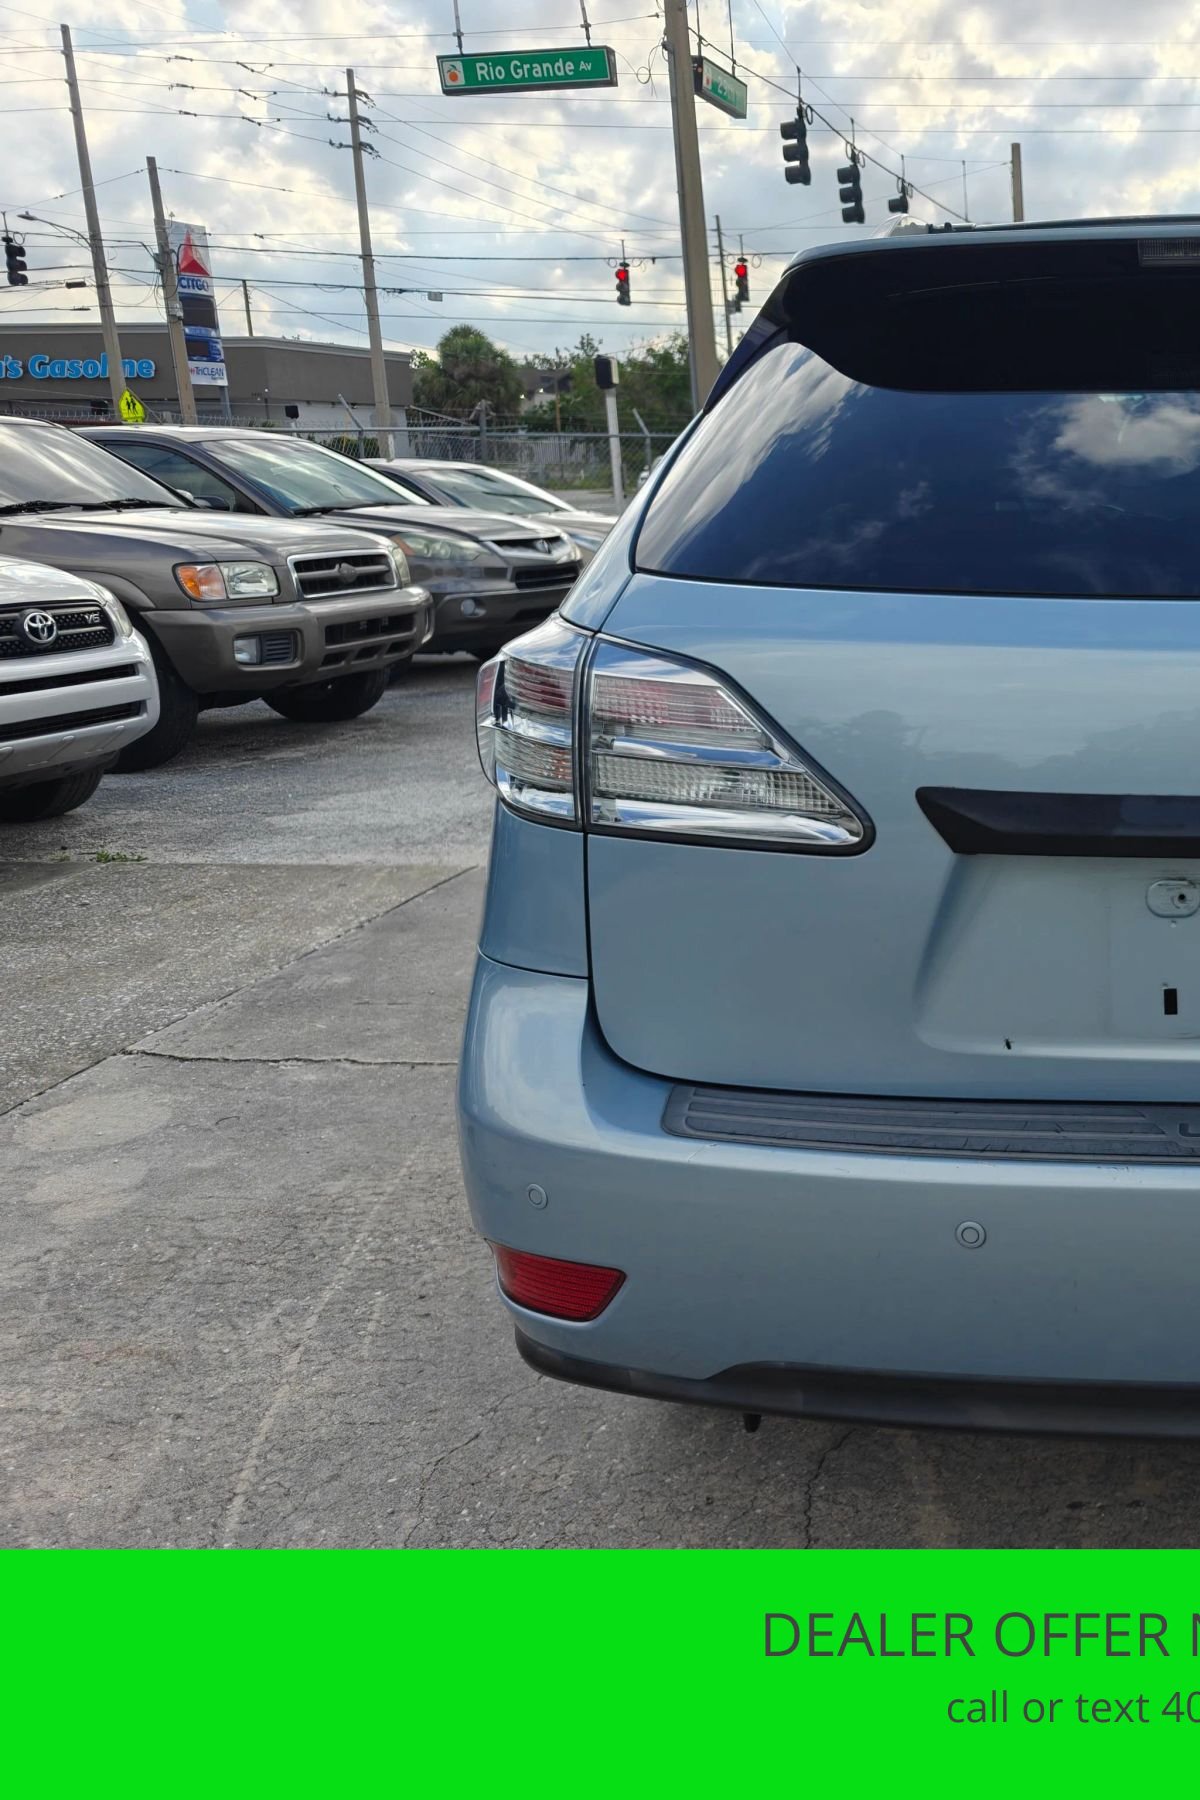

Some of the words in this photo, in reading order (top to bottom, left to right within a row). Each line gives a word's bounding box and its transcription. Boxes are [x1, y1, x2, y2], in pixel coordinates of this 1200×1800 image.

[475, 61, 506, 81] Rio
[510, 58, 575, 79] Grande
[579, 60, 592, 72] Av
[179, 277, 209, 292] CITGO
[28, 352, 156, 379] Gasolne
[84, 612, 100, 624] V6
